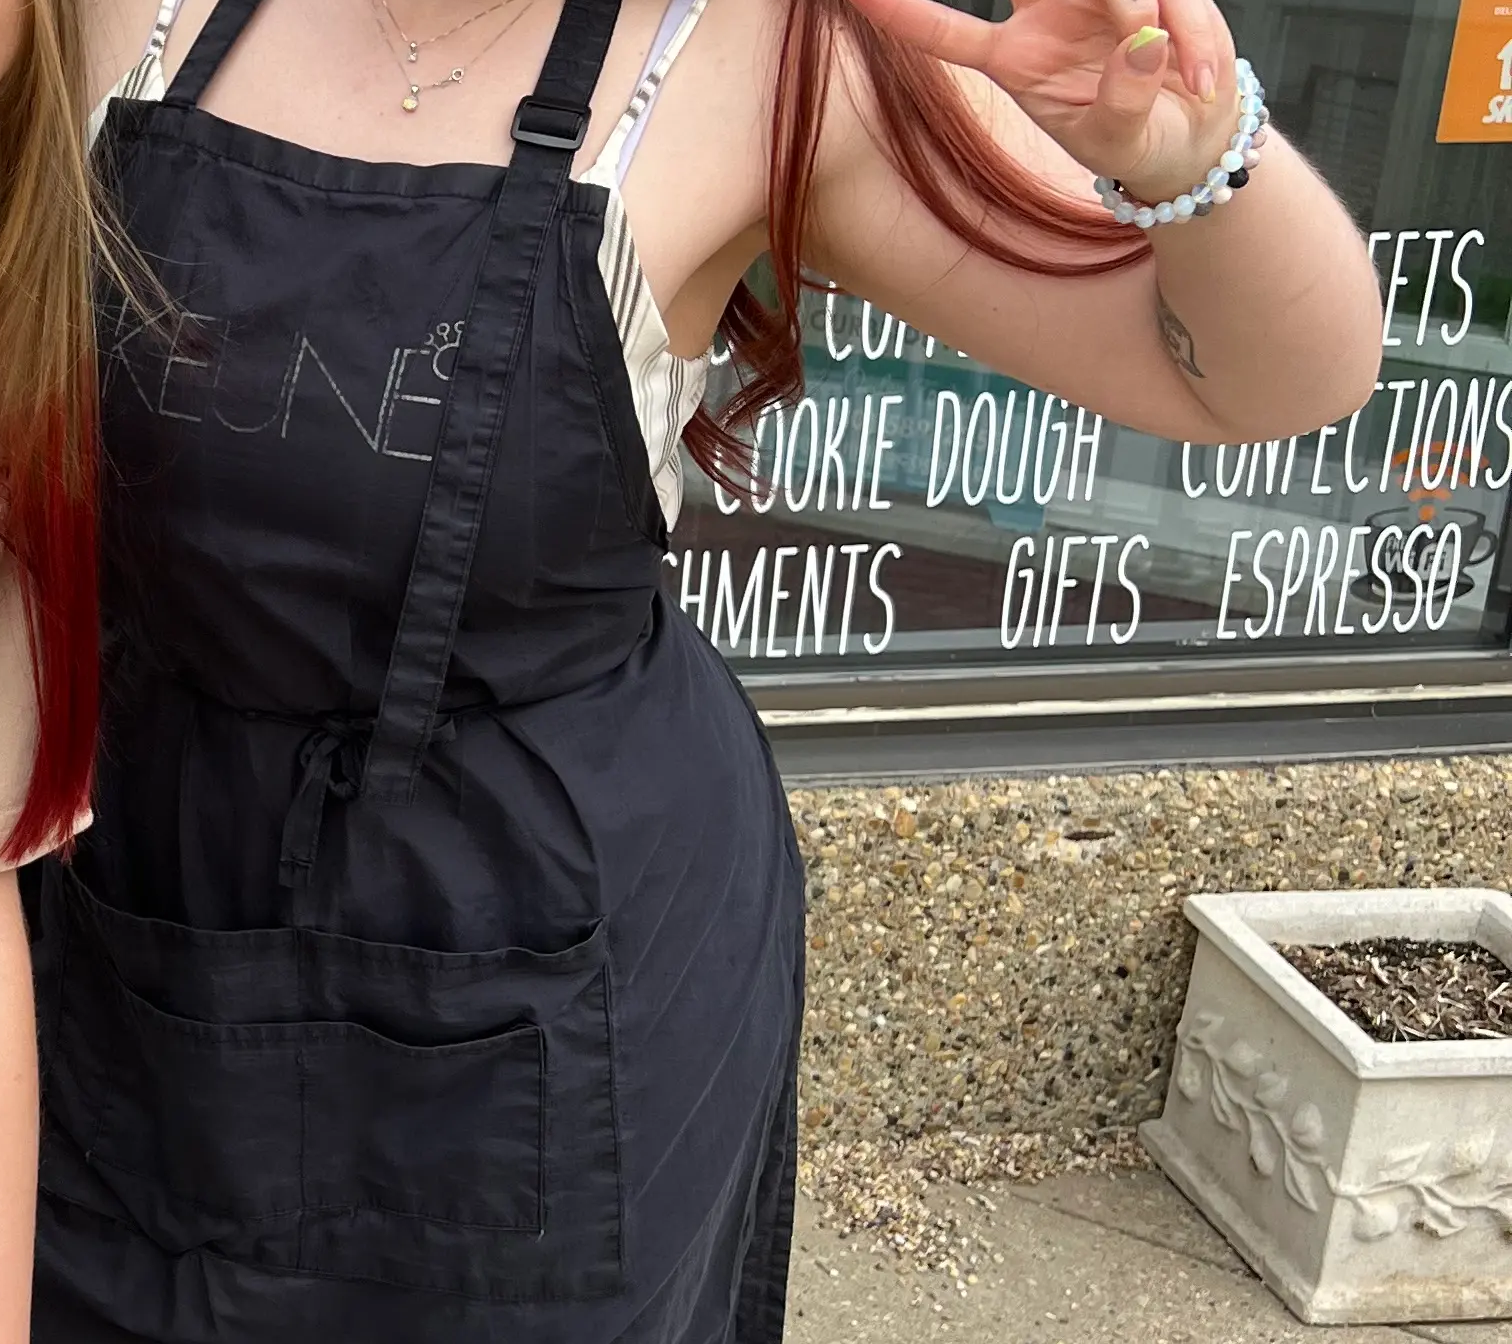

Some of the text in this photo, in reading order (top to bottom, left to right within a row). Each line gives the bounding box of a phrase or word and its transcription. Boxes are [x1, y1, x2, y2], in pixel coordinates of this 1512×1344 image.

[1368, 229, 1485, 346] ETS
[926, 390, 1102, 508] DOUGH
[662, 522, 1462, 658] HMENTS GIFTS ESPRESSO
